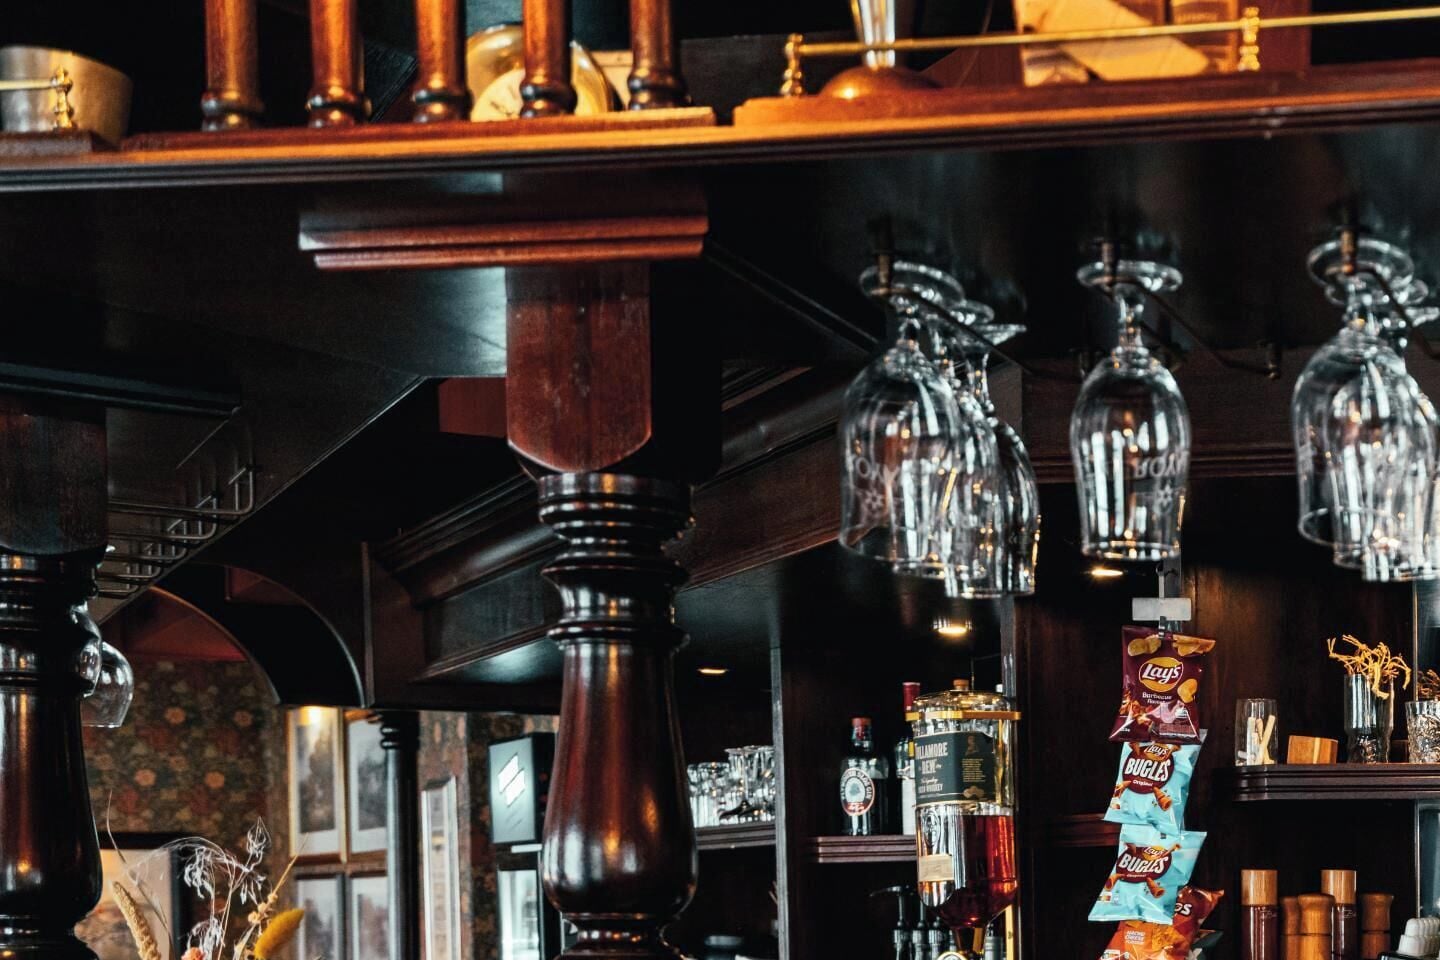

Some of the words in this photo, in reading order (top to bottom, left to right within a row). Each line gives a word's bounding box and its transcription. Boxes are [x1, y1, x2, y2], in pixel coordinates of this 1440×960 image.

[1142, 664, 1181, 684] Lay's
[1124, 758, 1171, 782] BUGLES
[1118, 853, 1169, 874] BUGLES
